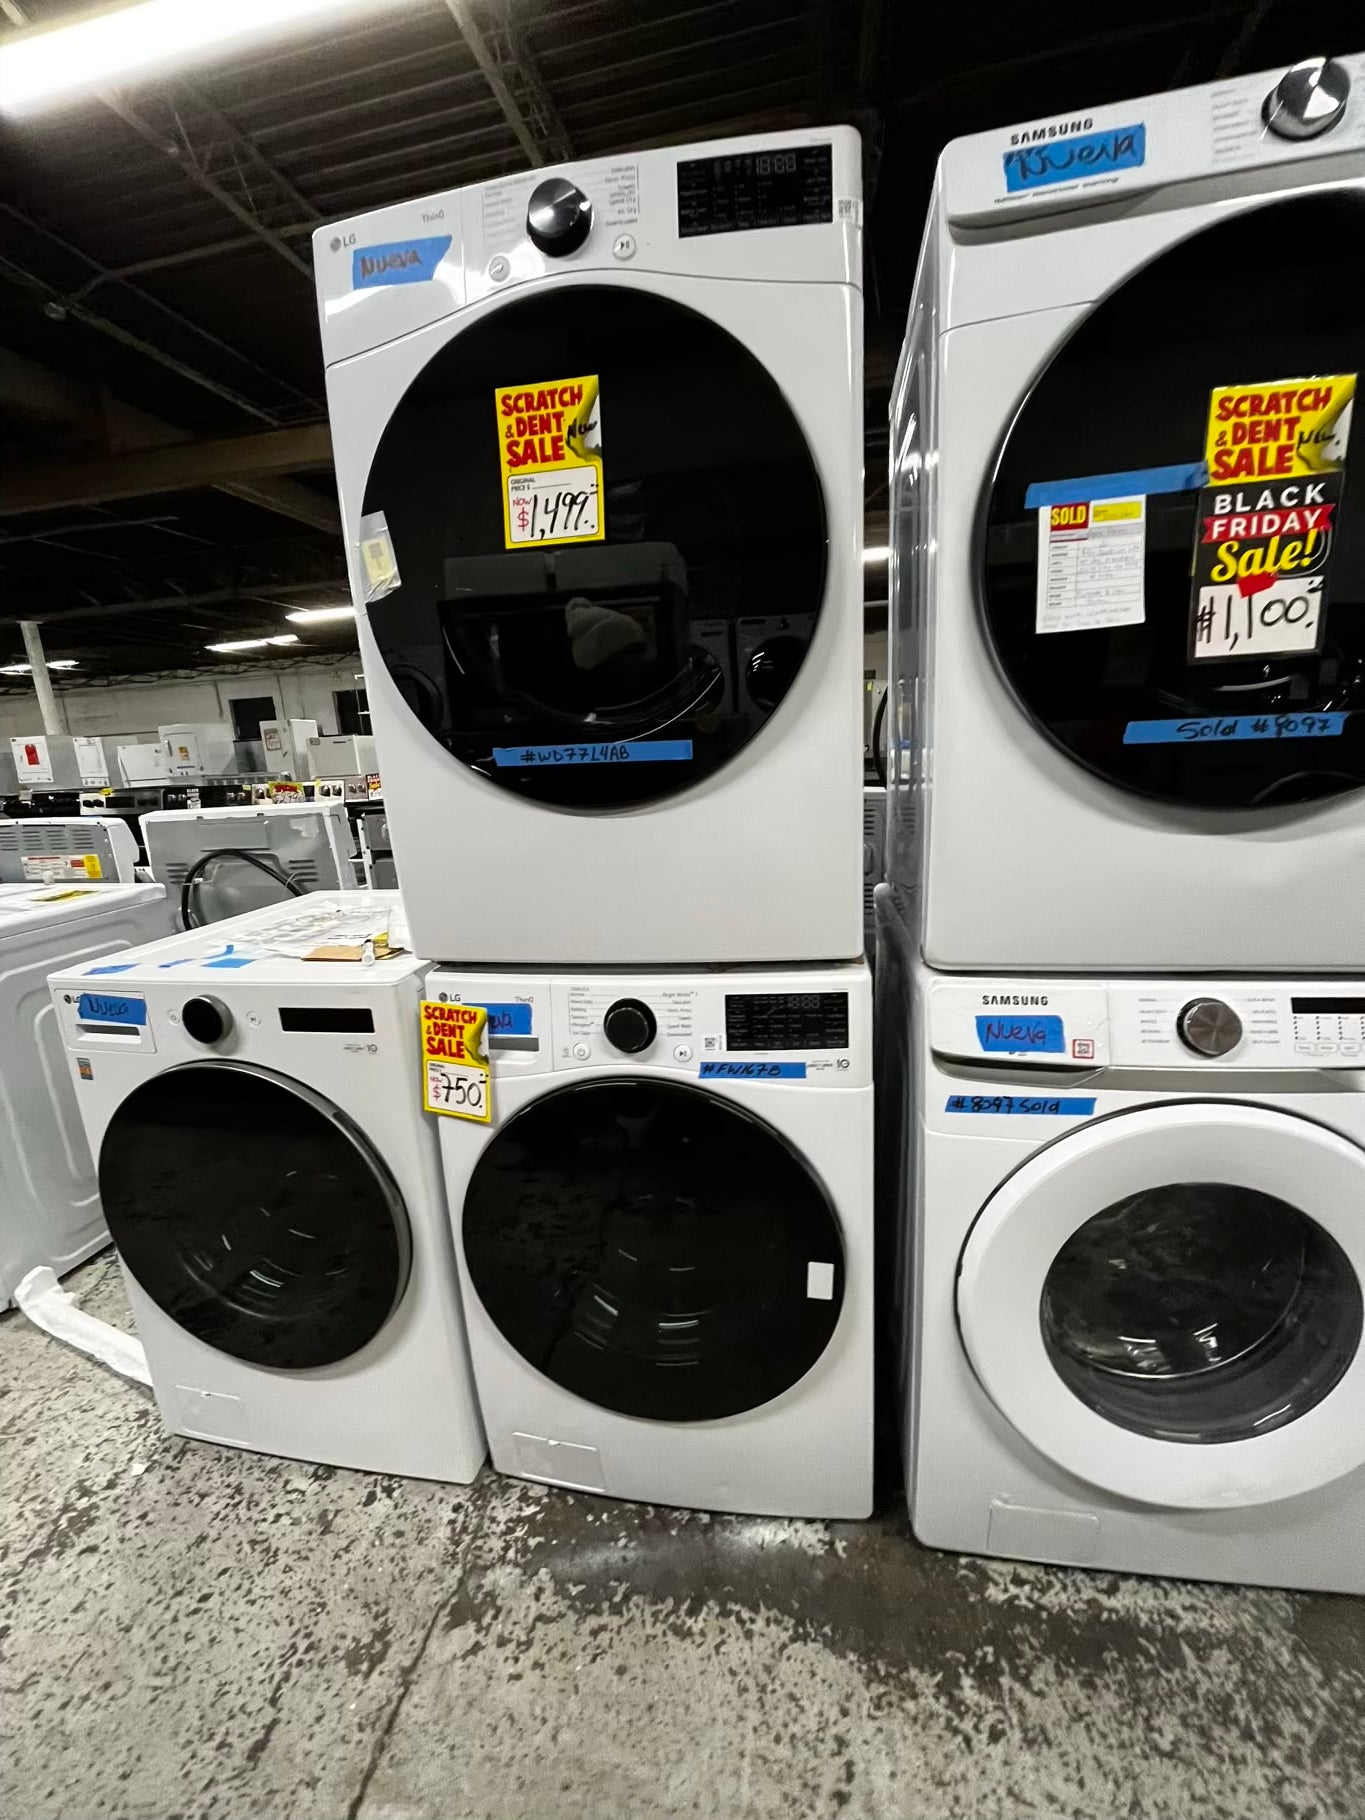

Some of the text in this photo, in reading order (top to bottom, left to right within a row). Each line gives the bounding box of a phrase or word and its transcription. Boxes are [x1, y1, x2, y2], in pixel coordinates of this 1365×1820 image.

[1010, 118, 1093, 146] SAMSUNG
[342, 233, 357, 247] LG
[501, 384, 583, 417] SCRATCH
[1215, 386, 1333, 421] SCRATCH
[505, 411, 565, 439] & DENT
[1215, 415, 1301, 447] & DENT
[506, 434, 566, 468] SALE
[1211, 443, 1296, 480] SALE
[1214, 482, 1327, 515] BLACK
[1051, 505, 1087, 526] SOLD
[1211, 508, 1322, 540] FRIDAY
[1211, 527, 1319, 583] Sale!
[1176, 720, 1238, 740] Sold
[450, 994, 461, 1002] LG
[982, 995, 1049, 1006] SAMSUNG
[424, 1005, 477, 1024] SCRATCH
[433, 1021, 465, 1039] DENT
[426, 1036, 466, 1059] SALE
